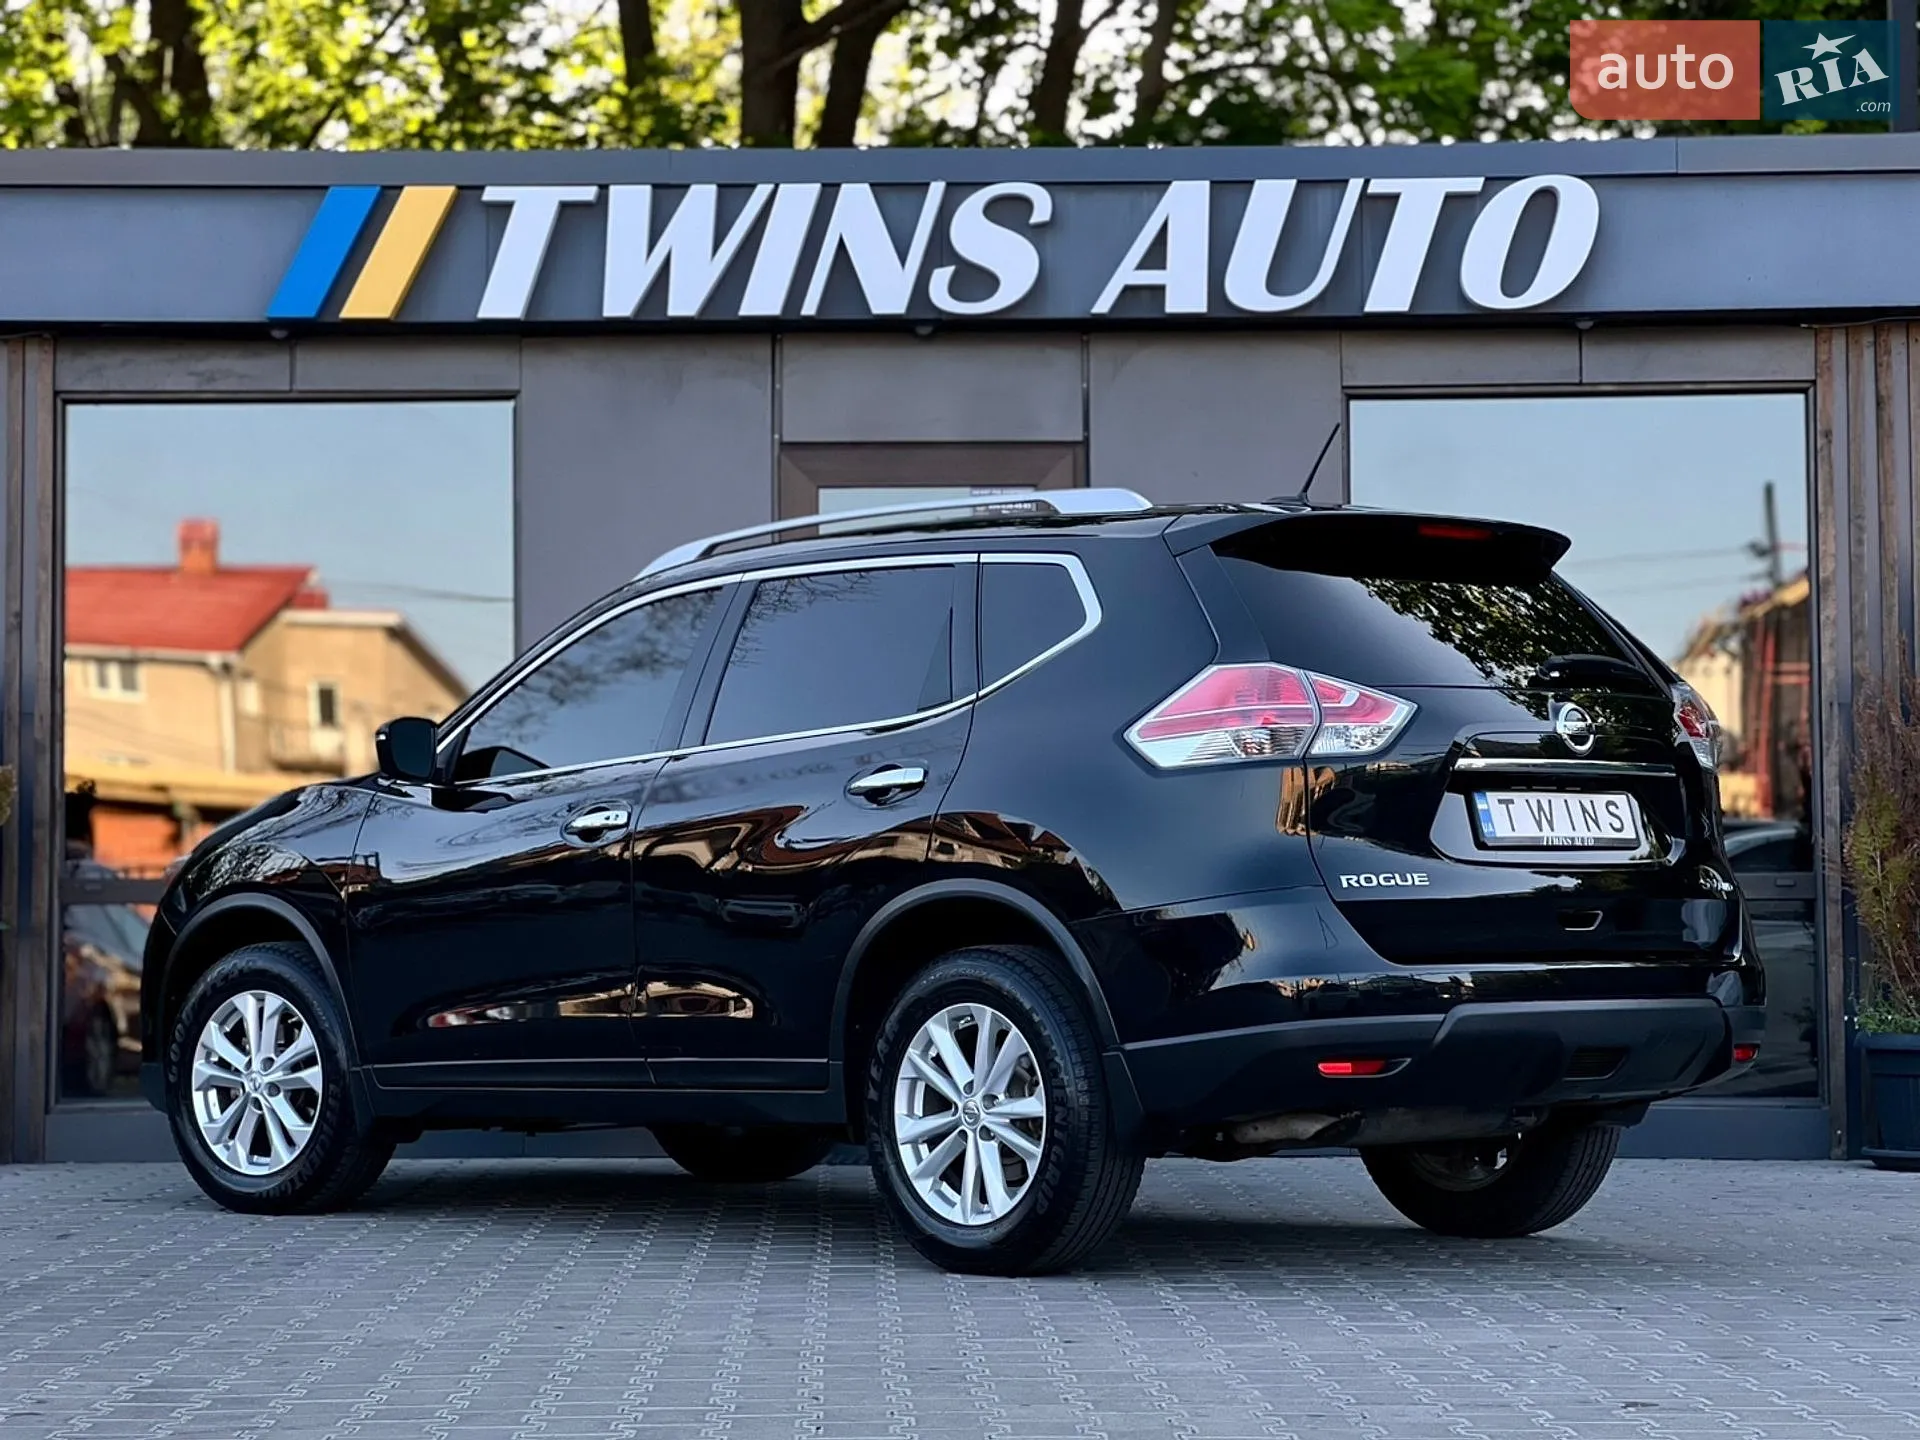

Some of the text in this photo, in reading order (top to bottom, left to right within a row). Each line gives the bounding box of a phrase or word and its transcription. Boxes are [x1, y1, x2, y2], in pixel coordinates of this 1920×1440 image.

[477, 174, 1600, 318] TWINS AUTO
[1498, 799, 1625, 833] TWINS
[1340, 873, 1430, 888] ROGUE
